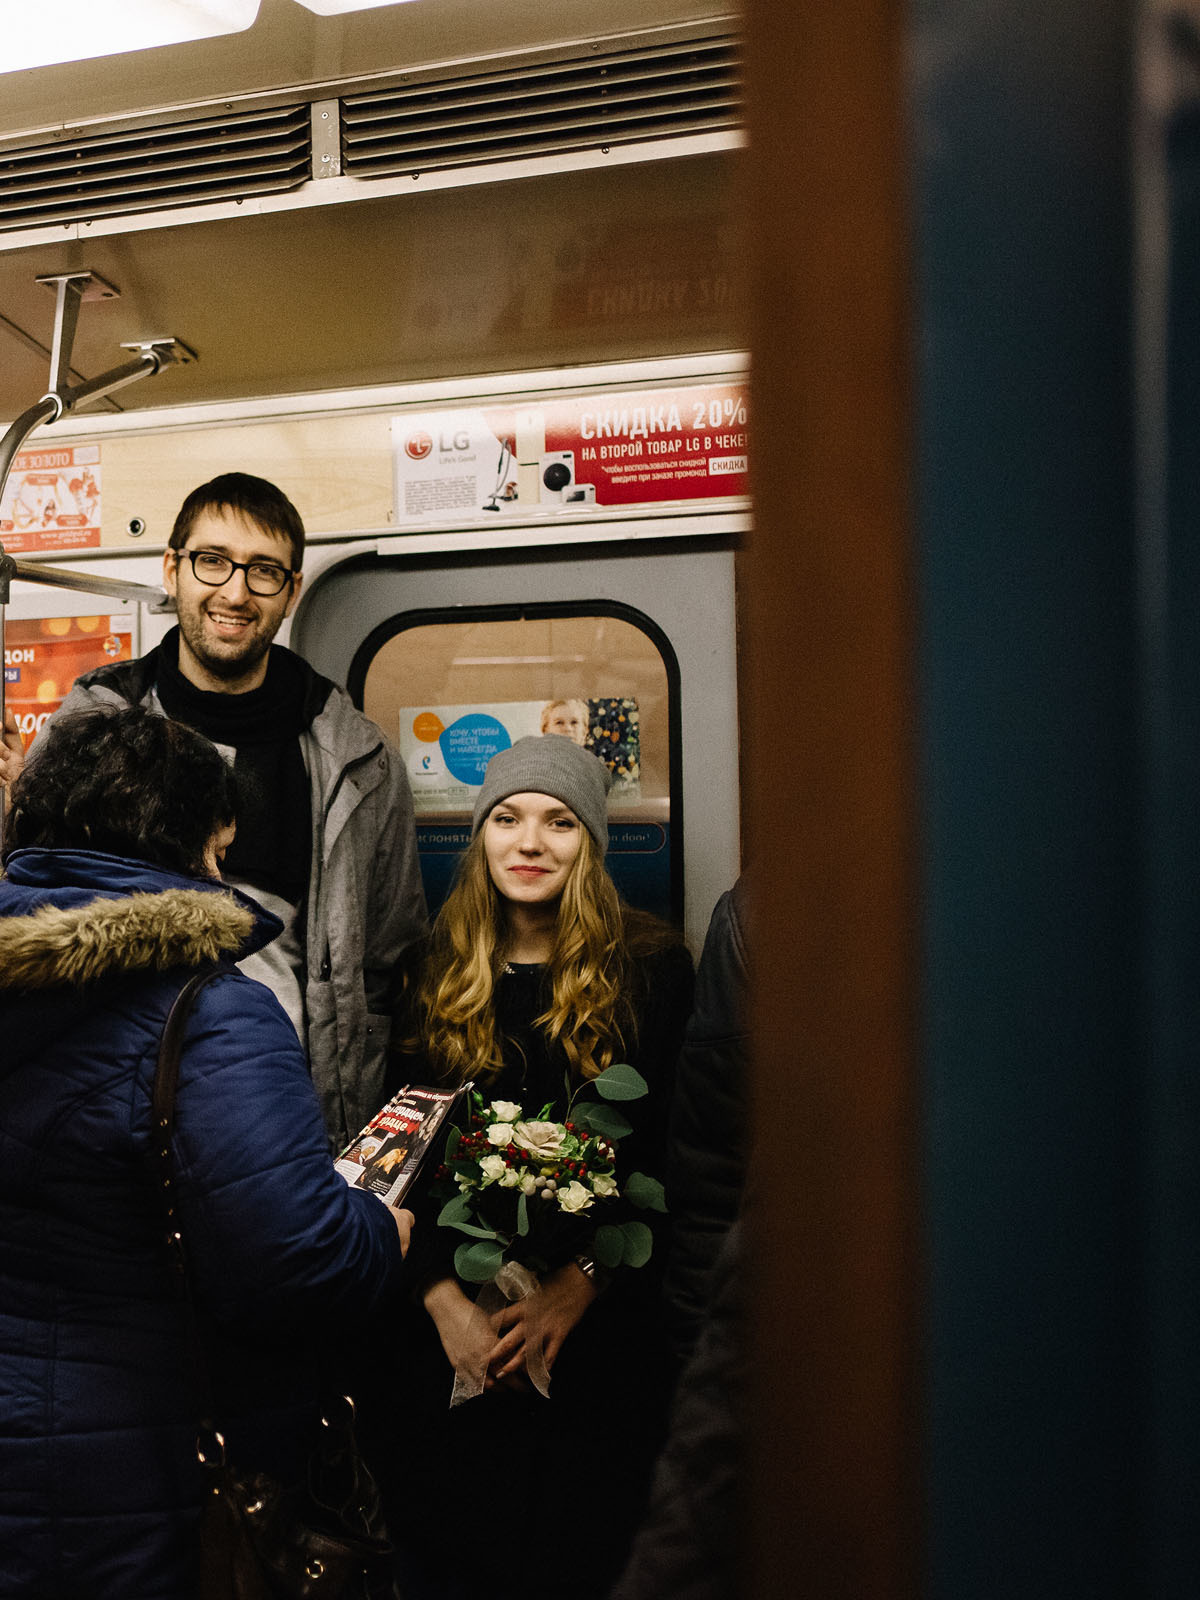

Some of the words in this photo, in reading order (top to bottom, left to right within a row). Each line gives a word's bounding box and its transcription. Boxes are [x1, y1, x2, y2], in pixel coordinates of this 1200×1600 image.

[581, 403, 682, 440] СКИДКА
[693, 397, 747, 429] 20%
[439, 431, 470, 452] LG
[582, 448, 597, 460] НА
[600, 441, 642, 459] ВТОРОЙ
[646, 439, 682, 454] ТОВАР
[686, 437, 700, 452] LG
[704, 436, 712, 450] В
[712, 460, 745, 472] СКИДКА
